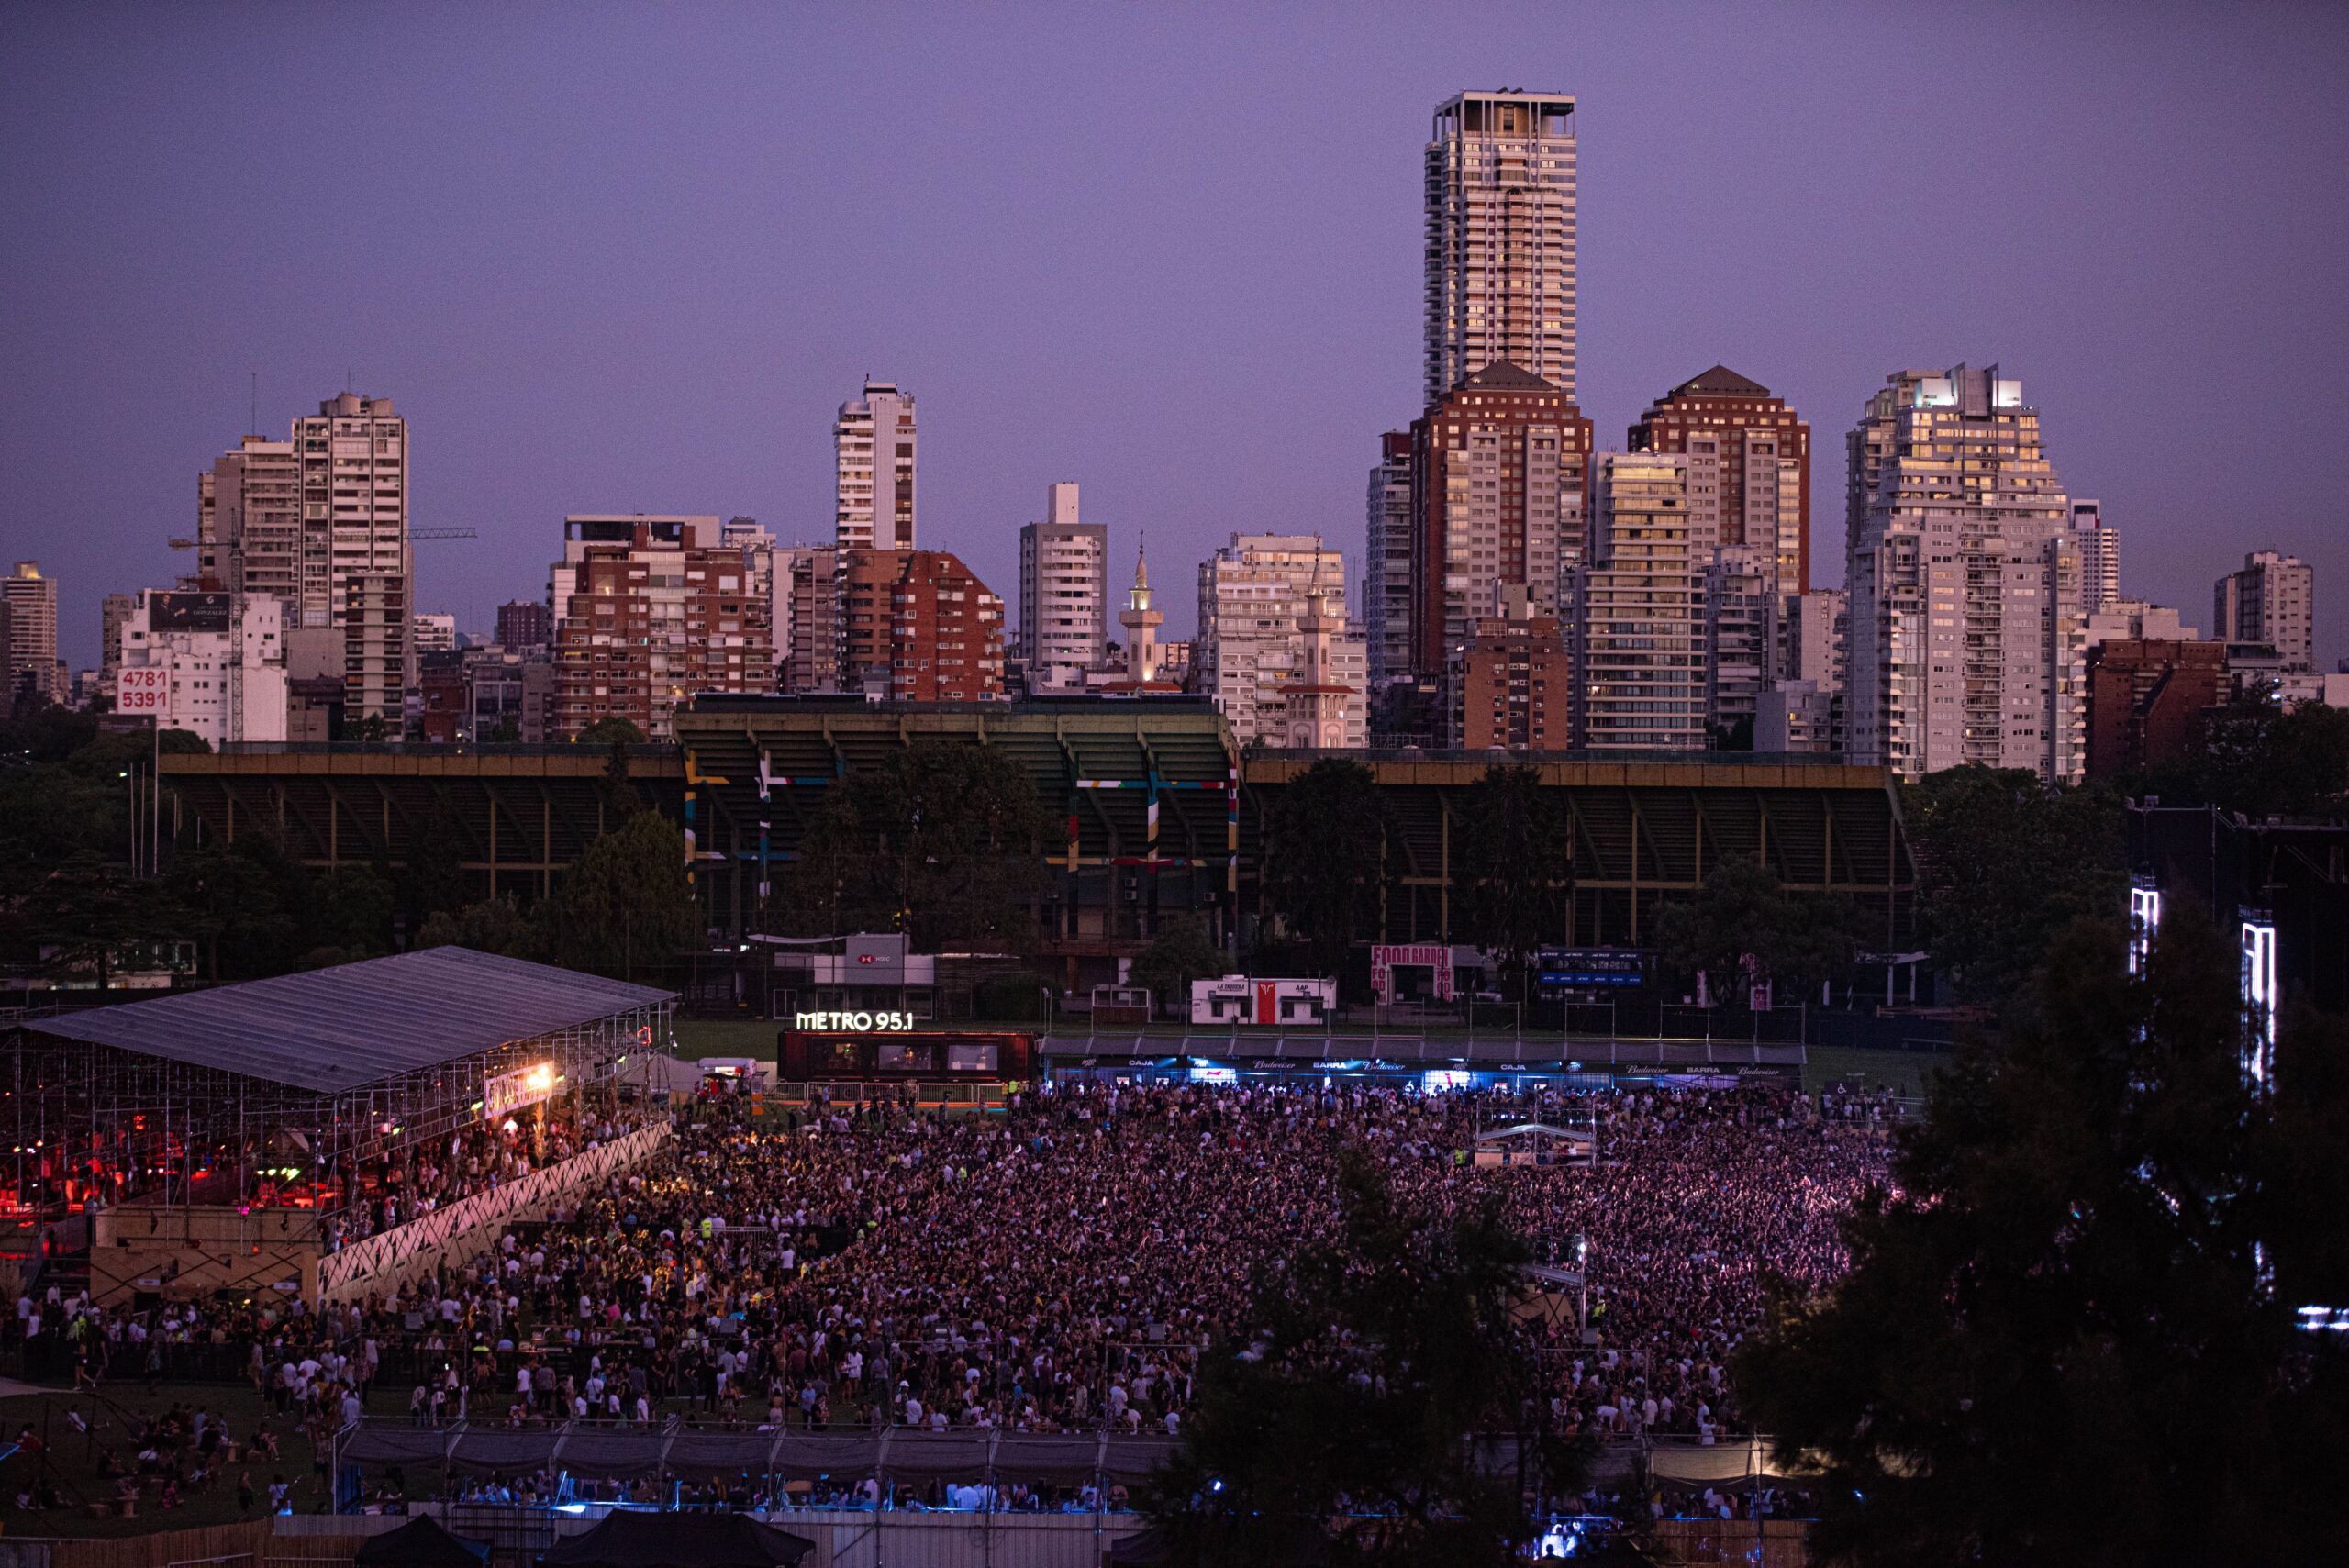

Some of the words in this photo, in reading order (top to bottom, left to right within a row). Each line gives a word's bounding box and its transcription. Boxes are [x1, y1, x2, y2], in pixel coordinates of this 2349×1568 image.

[123, 671, 166, 686] 4781
[123, 692, 166, 707] 5391
[1373, 946, 1410, 966] FOOD
[1412, 948, 1449, 967] GARDEN
[796, 1012, 872, 1031] METRO
[875, 1012, 913, 1030] 95.1
[1252, 1060, 1296, 1069] Budweiser
[1362, 1061, 1406, 1071] Budweiser
[1625, 1064, 1669, 1073] Budweiser
[1736, 1066, 1779, 1075] Budweiser
